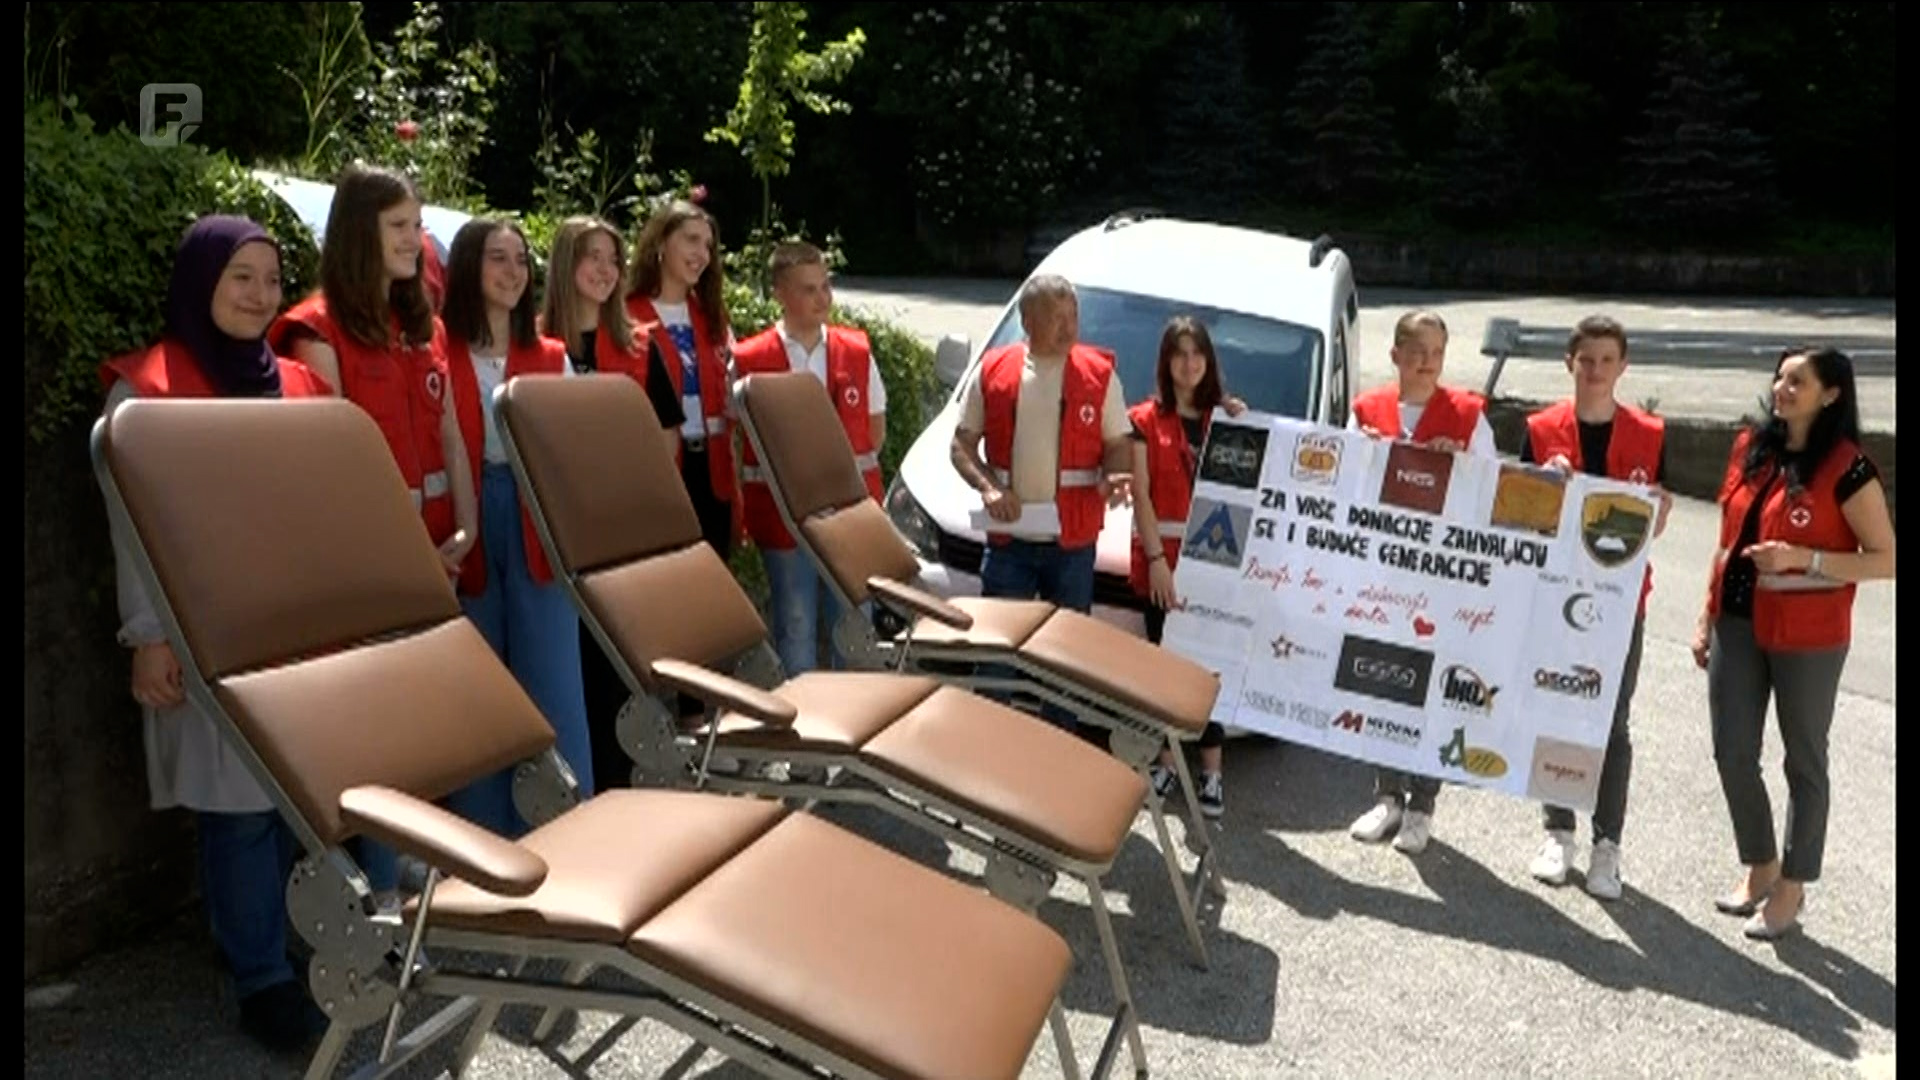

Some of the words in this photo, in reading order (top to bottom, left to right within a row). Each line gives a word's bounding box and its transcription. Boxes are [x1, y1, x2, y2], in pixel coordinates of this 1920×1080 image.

[1260, 487, 1286, 512] ZA
[1296, 494, 1337, 523] VAŠE
[1347, 503, 1433, 545] DONACIJE
[1287, 521, 1296, 543] I
[1379, 542, 1492, 587] GENERACIJE
